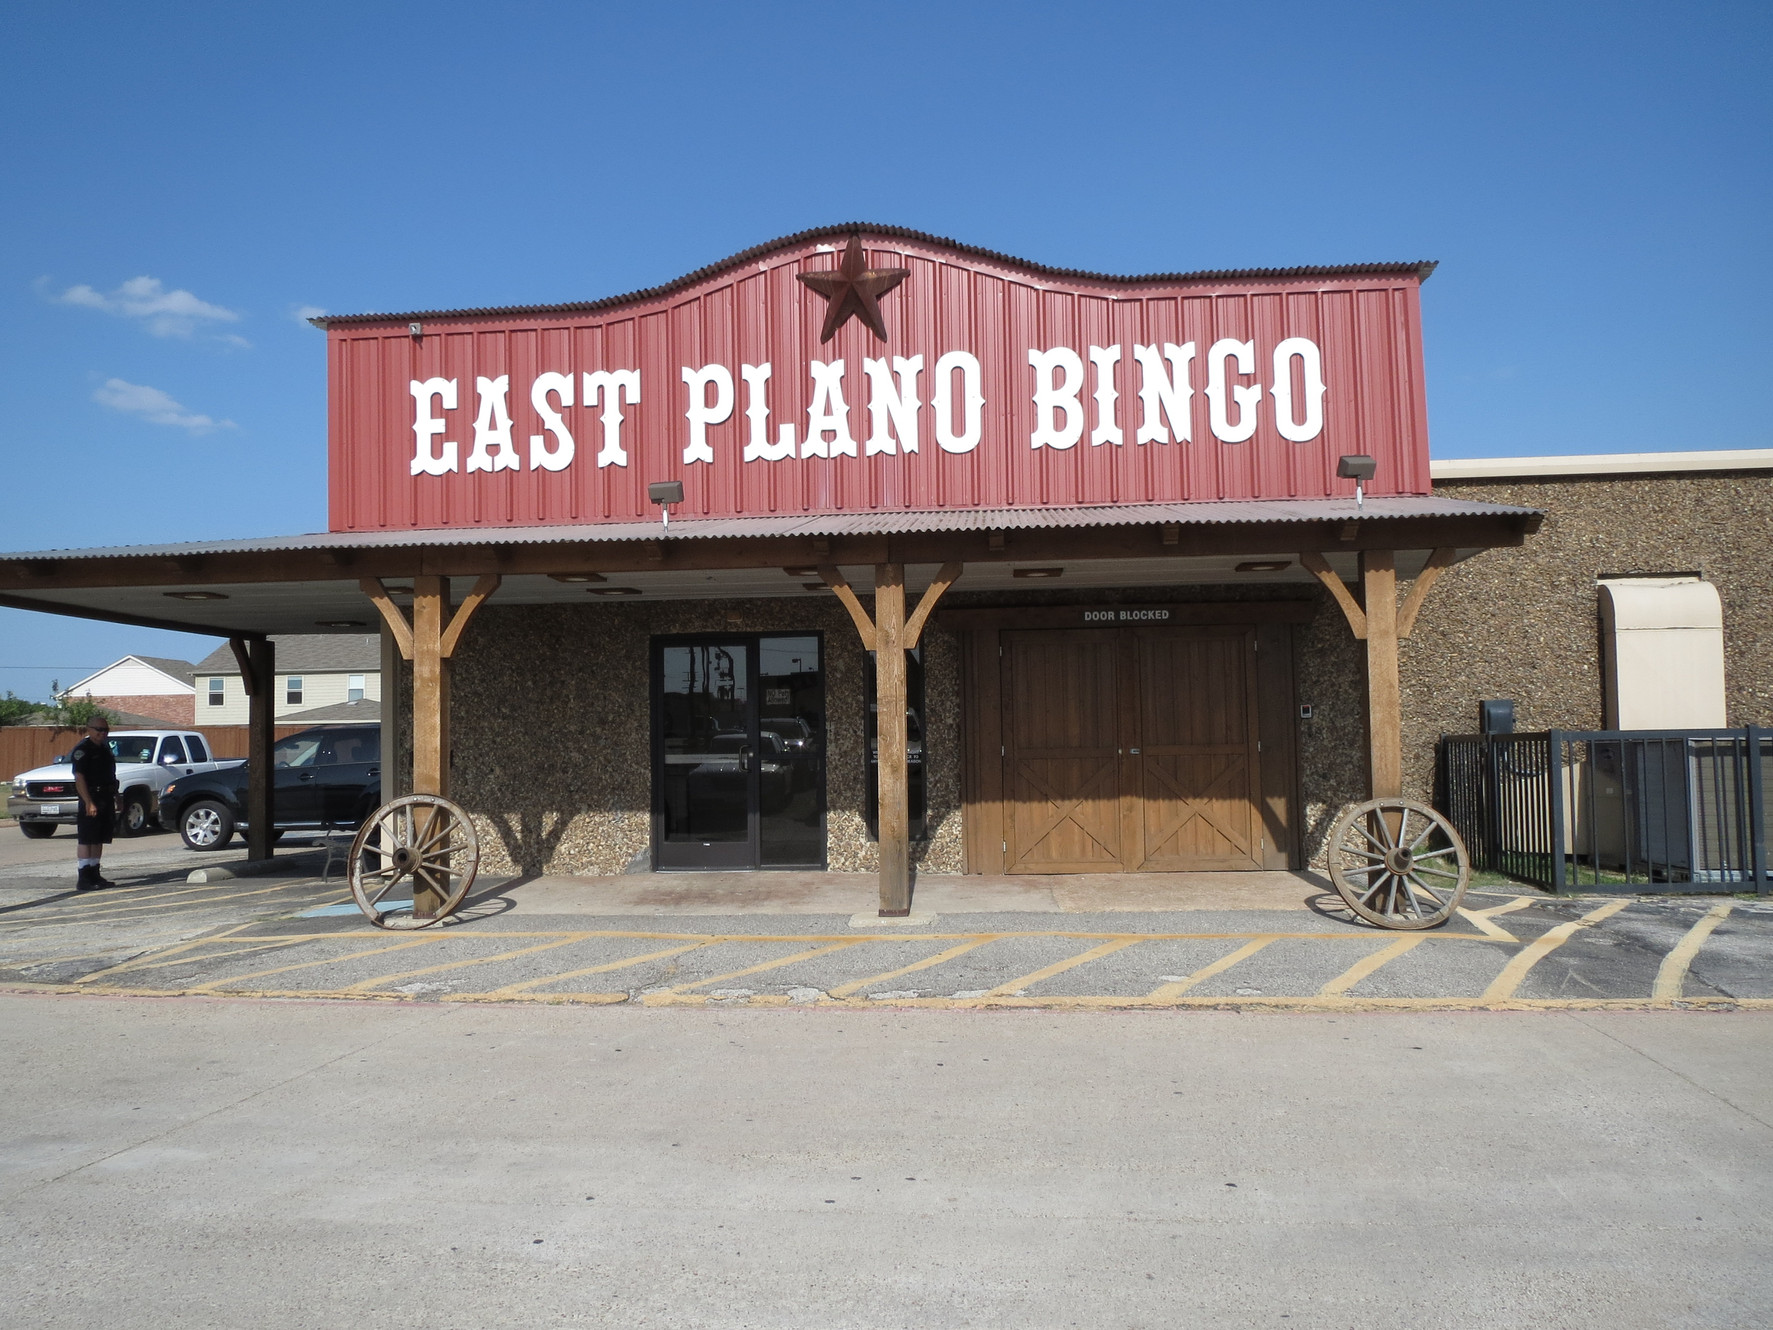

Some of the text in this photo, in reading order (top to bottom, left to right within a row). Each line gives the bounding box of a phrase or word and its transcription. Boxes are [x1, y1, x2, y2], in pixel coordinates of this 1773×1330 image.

[410, 337, 1327, 476] EAST PLANO BINGO
[1084, 609, 1169, 621] DOOR BLOCKED
